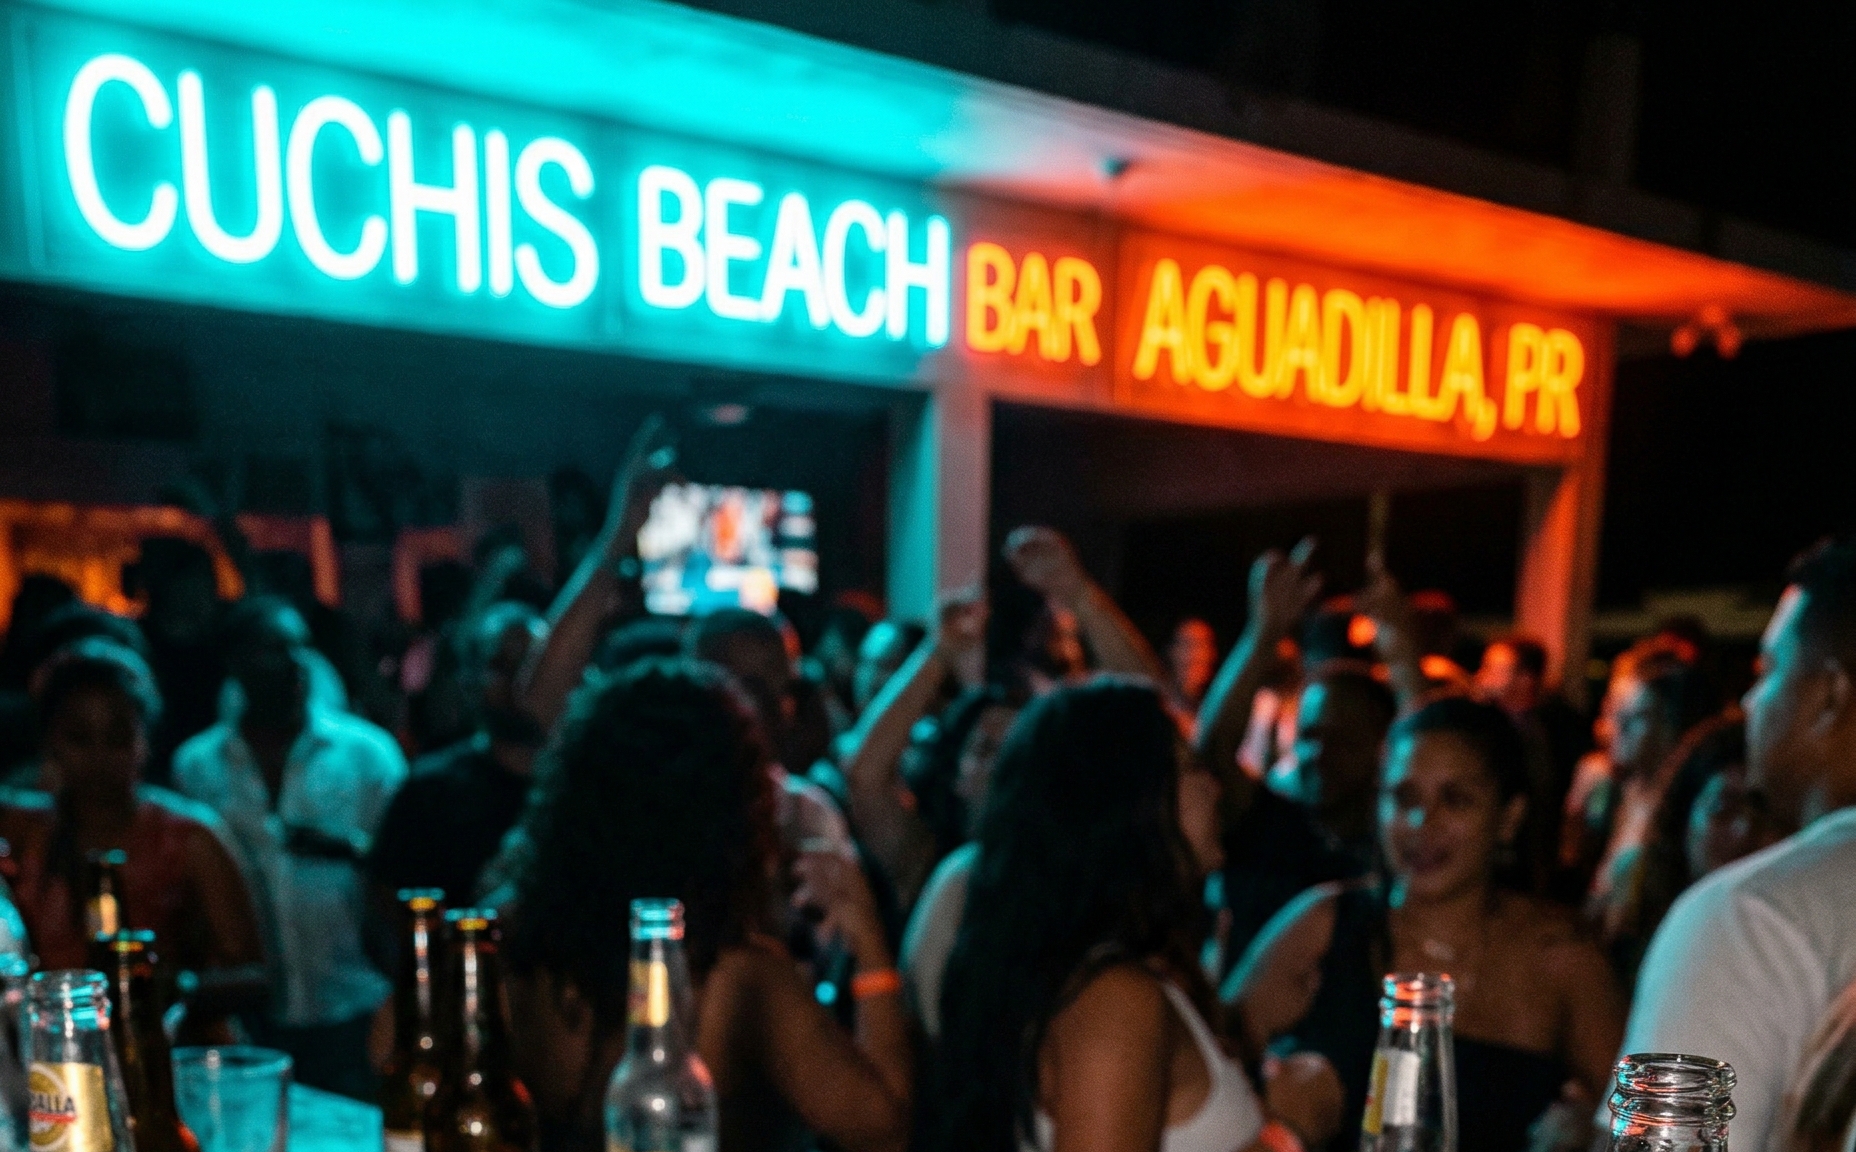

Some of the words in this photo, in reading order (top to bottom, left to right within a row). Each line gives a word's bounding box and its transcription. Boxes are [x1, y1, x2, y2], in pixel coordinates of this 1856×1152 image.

[63, 53, 601, 309] CUCHIS
[637, 164, 952, 347] BEACH
[966, 241, 1102, 367] BAR
[1131, 258, 1497, 441] AGUADILLA,
[1502, 322, 1585, 438] PR
